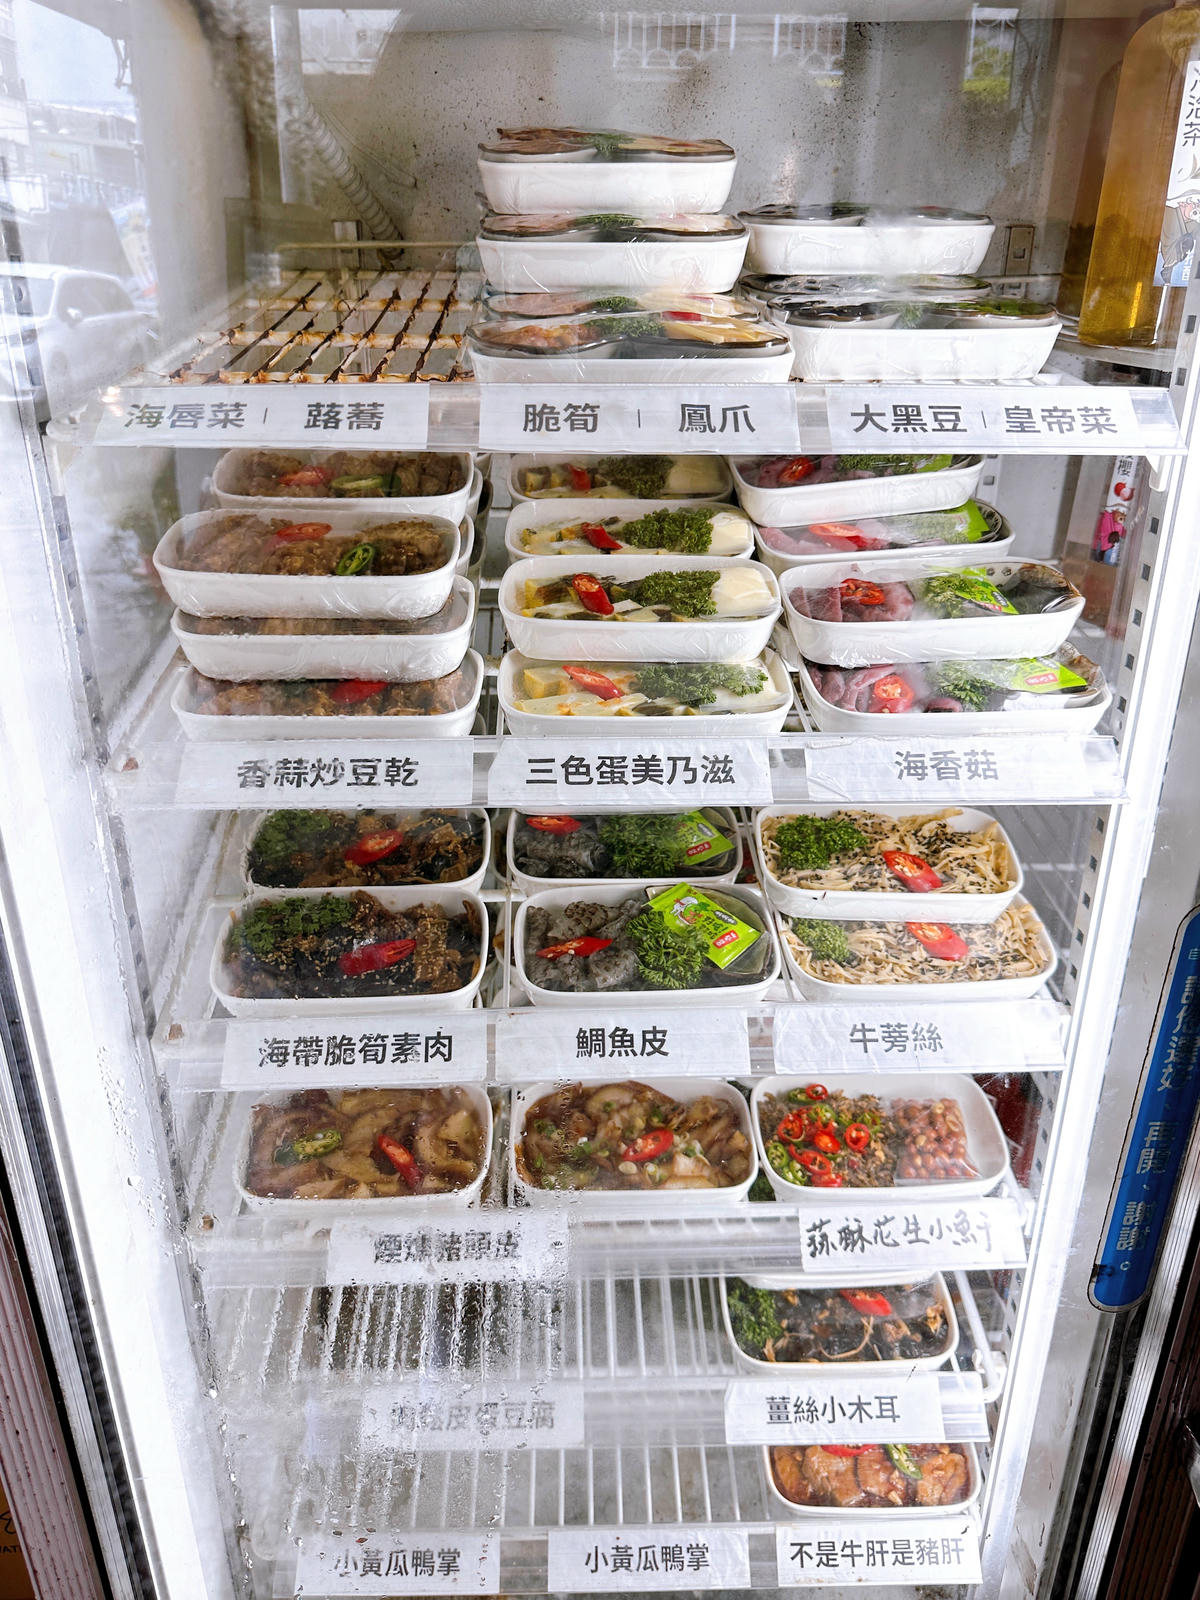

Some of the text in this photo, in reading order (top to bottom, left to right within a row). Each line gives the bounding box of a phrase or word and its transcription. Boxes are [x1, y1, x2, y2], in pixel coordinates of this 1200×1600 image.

[522, 402, 756, 434] 脆筍 鳳爪
[850, 404, 1118, 434] 大黑豆 皇帝菜
[236, 757, 419, 788] 香蒜炒豆乾
[525, 754, 736, 786] 三色蛋美乃滋
[894, 749, 1000, 781] 海香菇
[257, 1031, 453, 1068] 海帶脆筍素肉
[575, 1025, 670, 1058] 鯛魚皮
[849, 1022, 944, 1053] 牛蒡絲
[765, 1395, 900, 1425] 薑絲小木耳
[333, 1548, 461, 1577] 小黃瓜鴨掌
[584, 1543, 710, 1574] 小黃瓜鴨掌
[789, 1537, 965, 1569] 不是牛肝是豬肝
